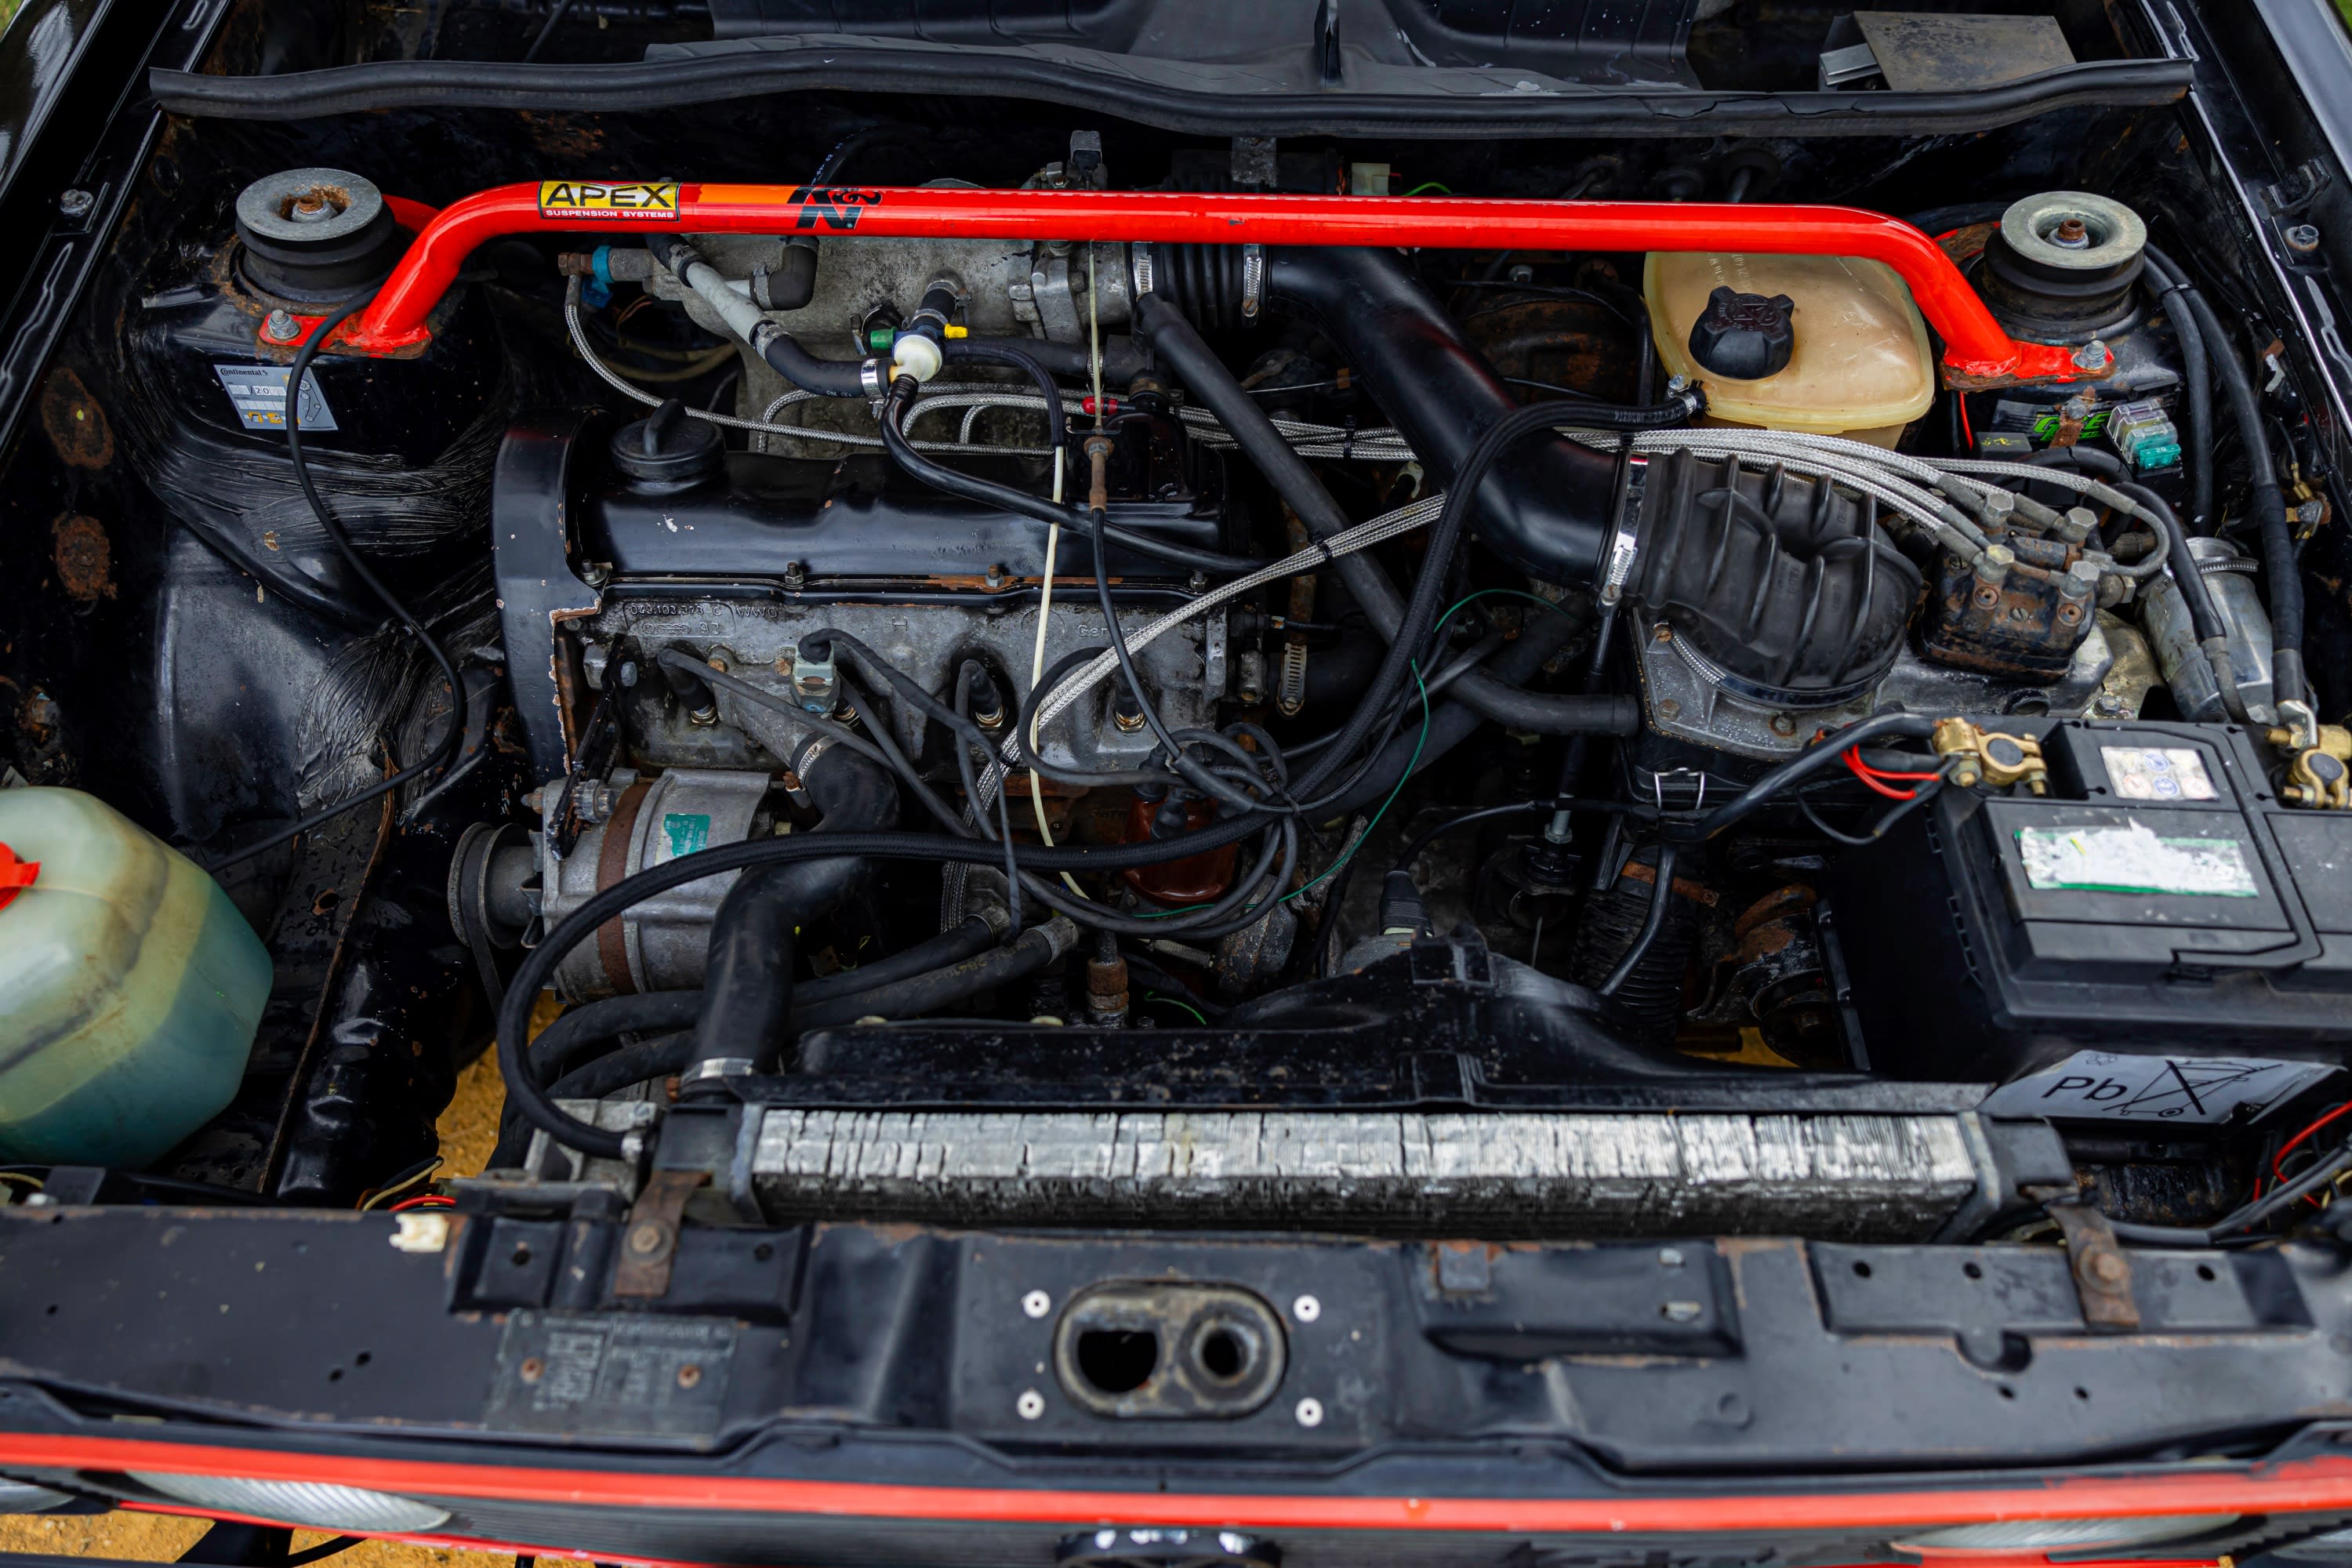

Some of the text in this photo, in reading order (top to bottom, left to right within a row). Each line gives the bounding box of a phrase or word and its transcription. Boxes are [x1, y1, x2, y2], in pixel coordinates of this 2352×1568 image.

[546, 183, 672, 208] APEX
[220, 368, 262, 376] Continental
[2041, 1076, 2128, 1101] Pb
